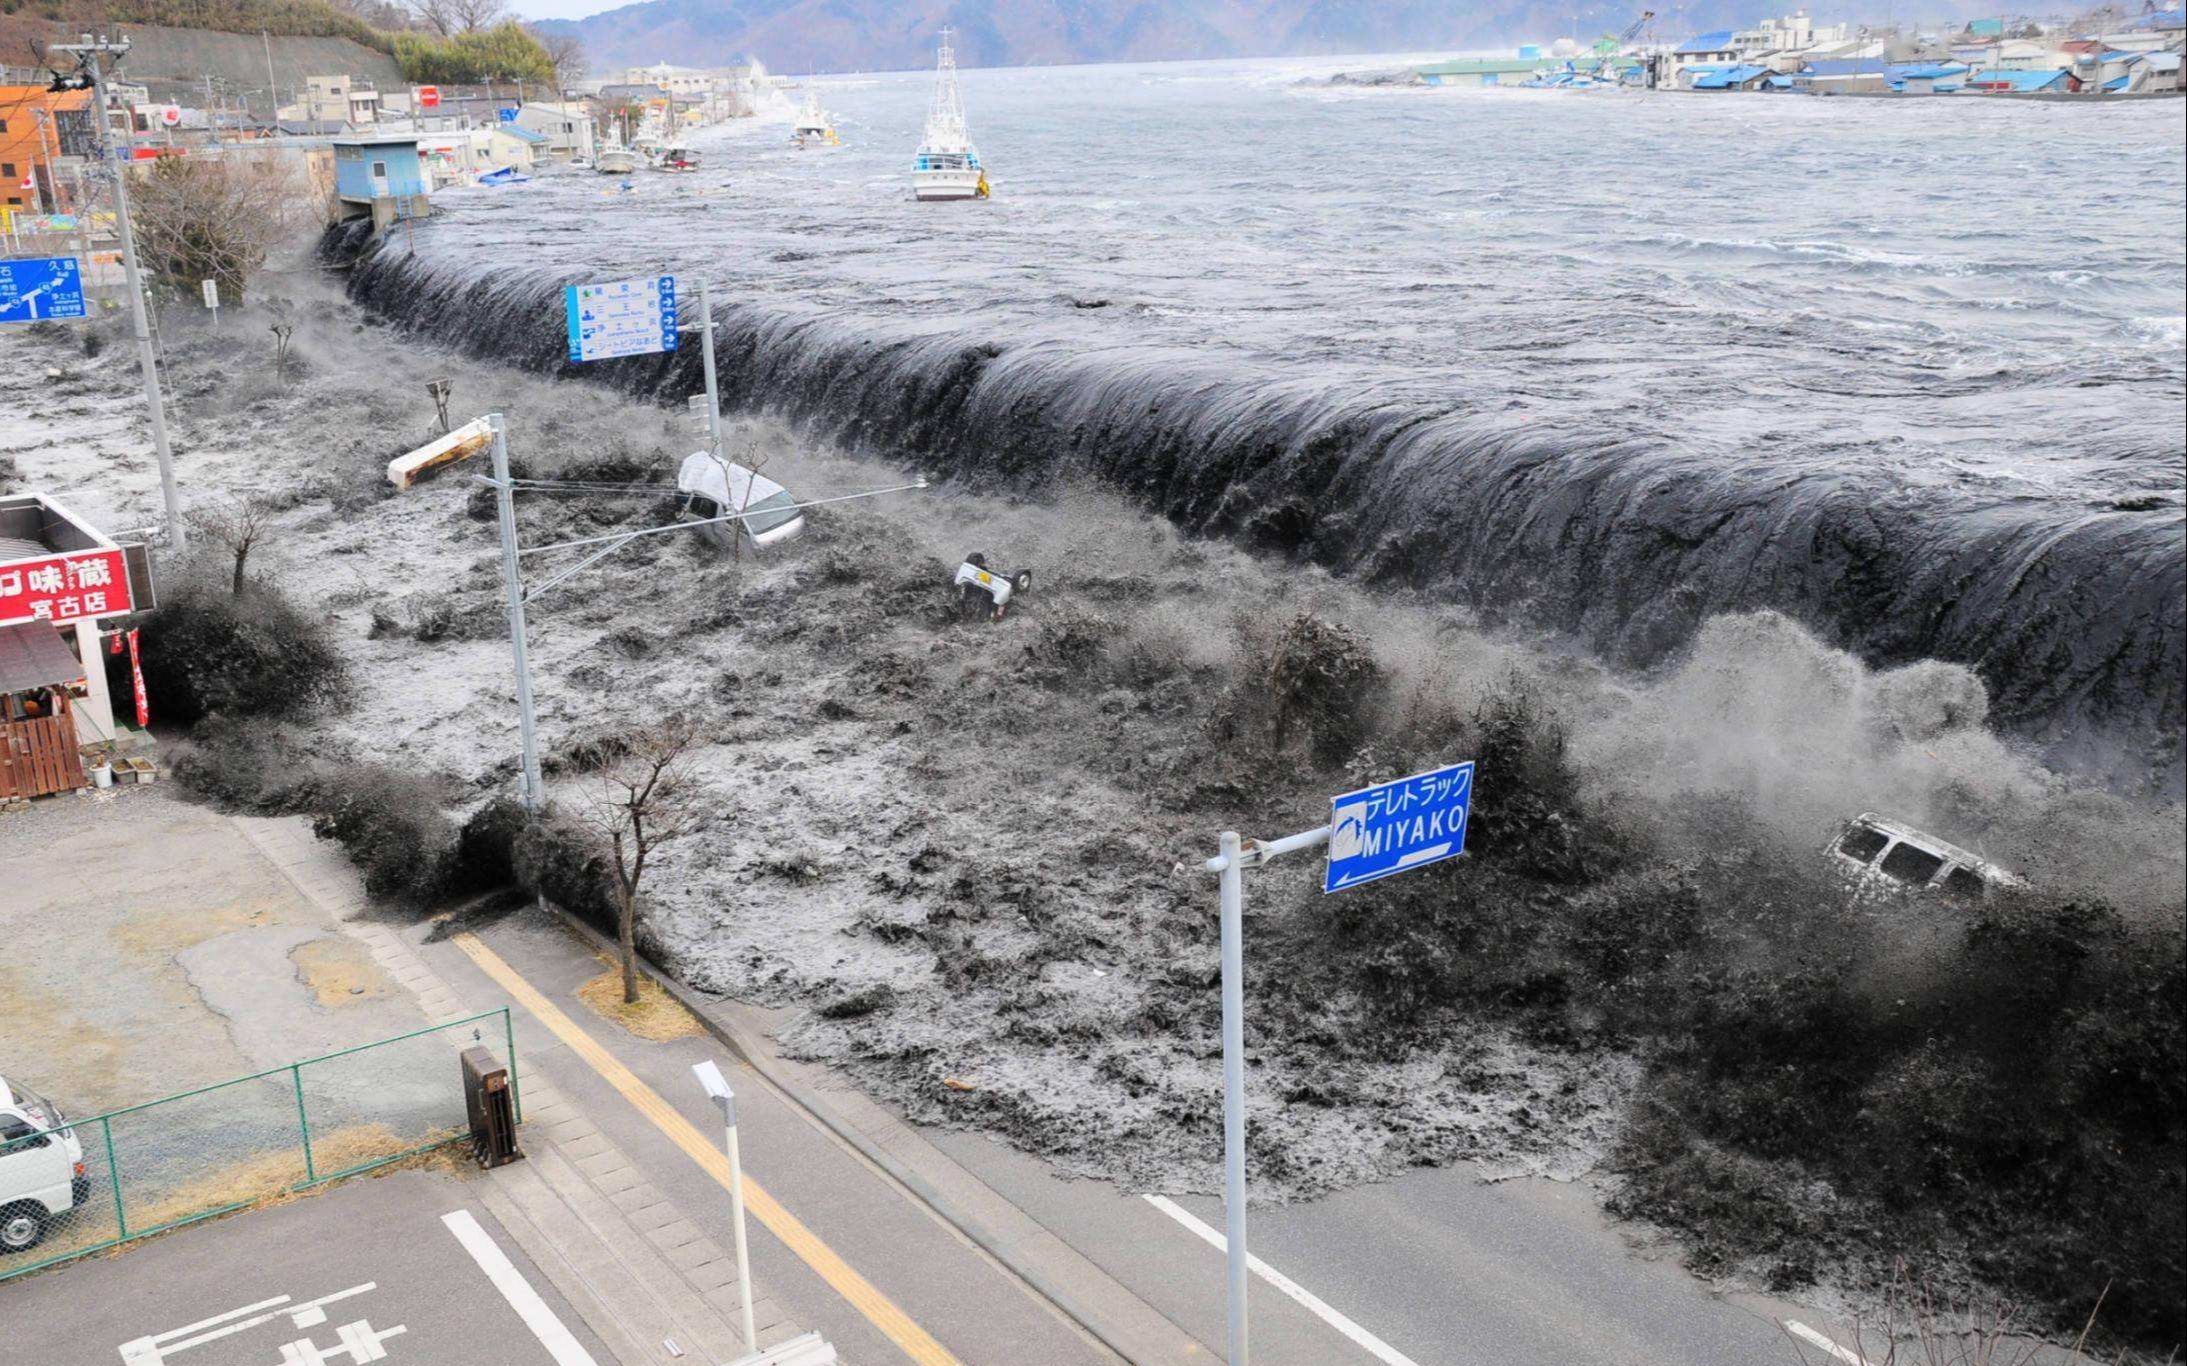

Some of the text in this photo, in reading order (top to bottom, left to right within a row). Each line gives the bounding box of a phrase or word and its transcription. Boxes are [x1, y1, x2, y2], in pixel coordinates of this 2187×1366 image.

[29, 592, 106, 619] 宮古店
[1367, 768, 1470, 821] テレトラック
[1362, 805, 1464, 858] MIYAKO
